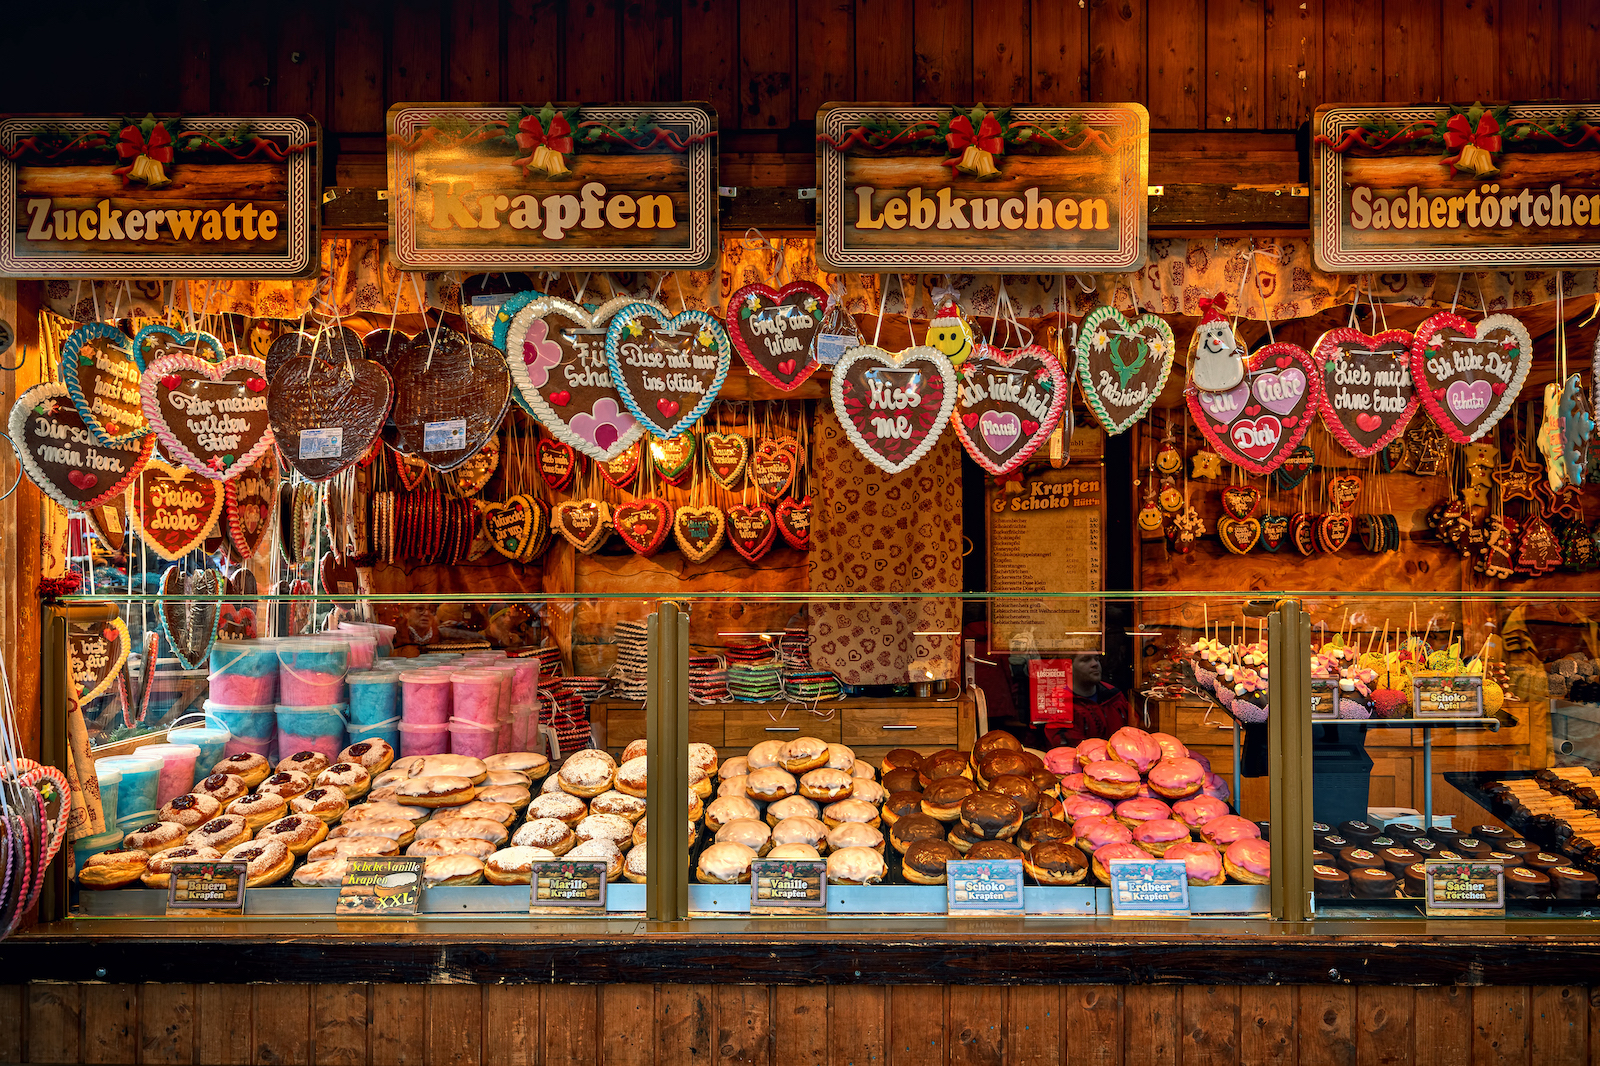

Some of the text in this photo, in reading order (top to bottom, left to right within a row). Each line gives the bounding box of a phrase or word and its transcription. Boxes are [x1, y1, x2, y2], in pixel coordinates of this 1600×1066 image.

[428, 181, 677, 240] Krapfen
[855, 187, 1111, 231] Lebkuchen
[26, 198, 279, 241] Zuckerwatte
[749, 314, 814, 340] Gruß aus
[573, 341, 607, 368] Fü
[763, 336, 804, 357] Wien
[666, 350, 692, 369] mit
[692, 348, 719, 370] mir
[1427, 348, 1513, 385] Ich liebe Dich
[642, 371, 666, 392] ins
[1334, 361, 1412, 387] Lieb mich
[868, 378, 922, 410] Kiss
[987, 374, 1021, 401] liebe
[1018, 385, 1050, 423] Dich
[1256, 375, 1301, 403] liebe
[168, 391, 268, 415] Für meinen
[1335, 387, 1407, 413] ohne Ende
[187, 413, 250, 433] wilden
[871, 416, 913, 439] me
[982, 418, 1017, 436] Mausi
[197, 432, 241, 451] Stier
[1234, 423, 1279, 449] Dich
[37, 443, 125, 473] mein Herz
[1030, 478, 1100, 497] Krapfen
[992, 498, 1007, 512] &
[1010, 494, 1070, 512] Schoko
[150, 508, 201, 531] Liebe
[81, 637, 107, 654] bist
[85, 654, 109, 669] für
[1430, 692, 1467, 702] Schoko
[1438, 701, 1460, 710] Apfel
[187, 881, 227, 892] Bauern
[347, 873, 389, 886] Krapfen
[549, 879, 588, 890] Marille
[770, 879, 808, 890] Vanille
[965, 881, 1006, 893] Schoko
[1128, 881, 1172, 893] Erdbeer
[1446, 881, 1485, 891] Sacher
[188, 891, 224, 901] Krapfen
[376, 891, 415, 911] XXL
[550, 889, 586, 900] Krapfen
[770, 889, 807, 900] Krapfen
[968, 891, 1004, 902] Krapfen
[1133, 891, 1169, 902] Krapfen
[1445, 890, 1487, 900] Törtchen
